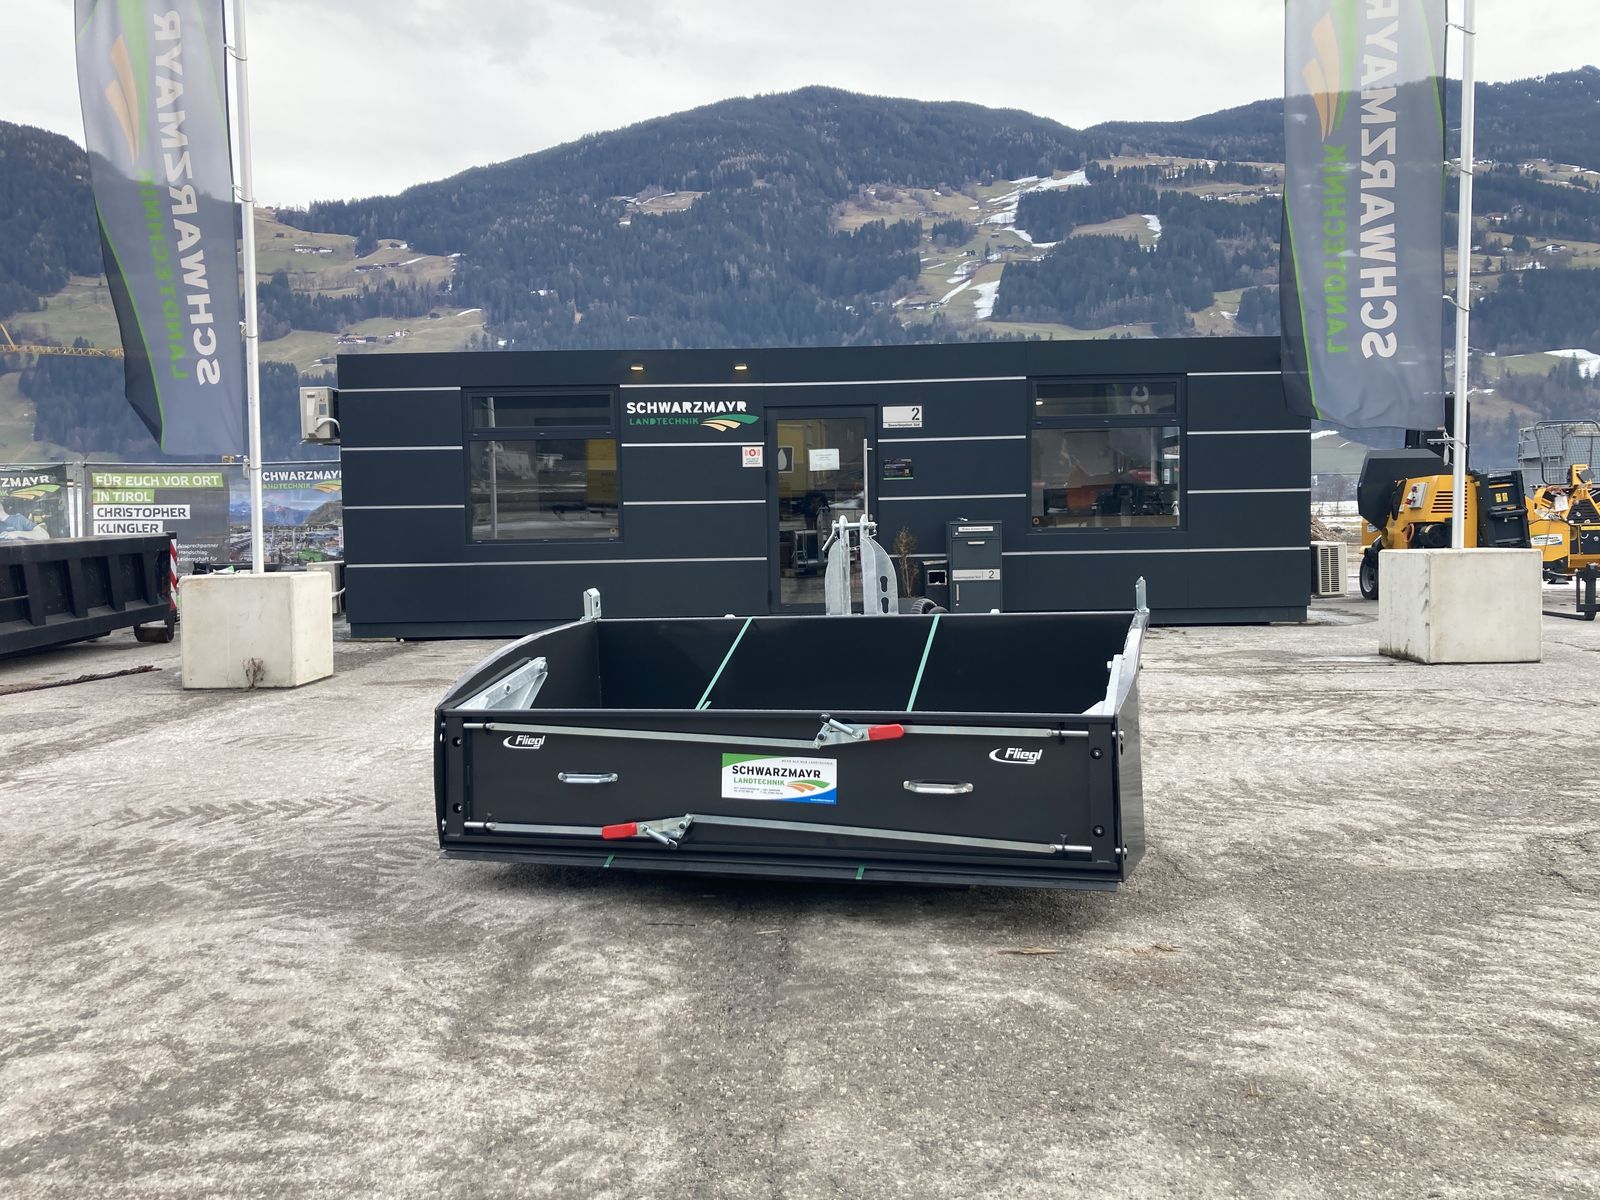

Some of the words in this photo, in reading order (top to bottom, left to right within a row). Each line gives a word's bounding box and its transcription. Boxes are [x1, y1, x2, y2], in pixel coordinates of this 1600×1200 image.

[626, 400, 747, 414] SCHWARZMAYR
[911, 407, 920, 421] 2
[629, 417, 699, 426] LANDTECHNIK
[0, 474, 50, 488] ZMAYR
[96, 473, 122, 486] FÜR
[125, 475, 160, 486] EUCH
[161, 475, 190, 486] VOR
[192, 475, 220, 486] ORT
[262, 469, 342, 481] CHWARZMAY
[263, 482, 311, 490] ANDTECHNIK
[96, 491, 110, 502] IN
[112, 491, 152, 502] TIROL
[97, 507, 188, 518] CHRISTOPHER
[97, 523, 159, 534] KLINGLER
[988, 570, 994, 579] 2
[515, 734, 546, 749] Fliegl
[1005, 747, 1043, 765] Fliegl
[732, 765, 821, 779] SCHWARZMAYR
[733, 777, 785, 786] LANDTECHNIK
